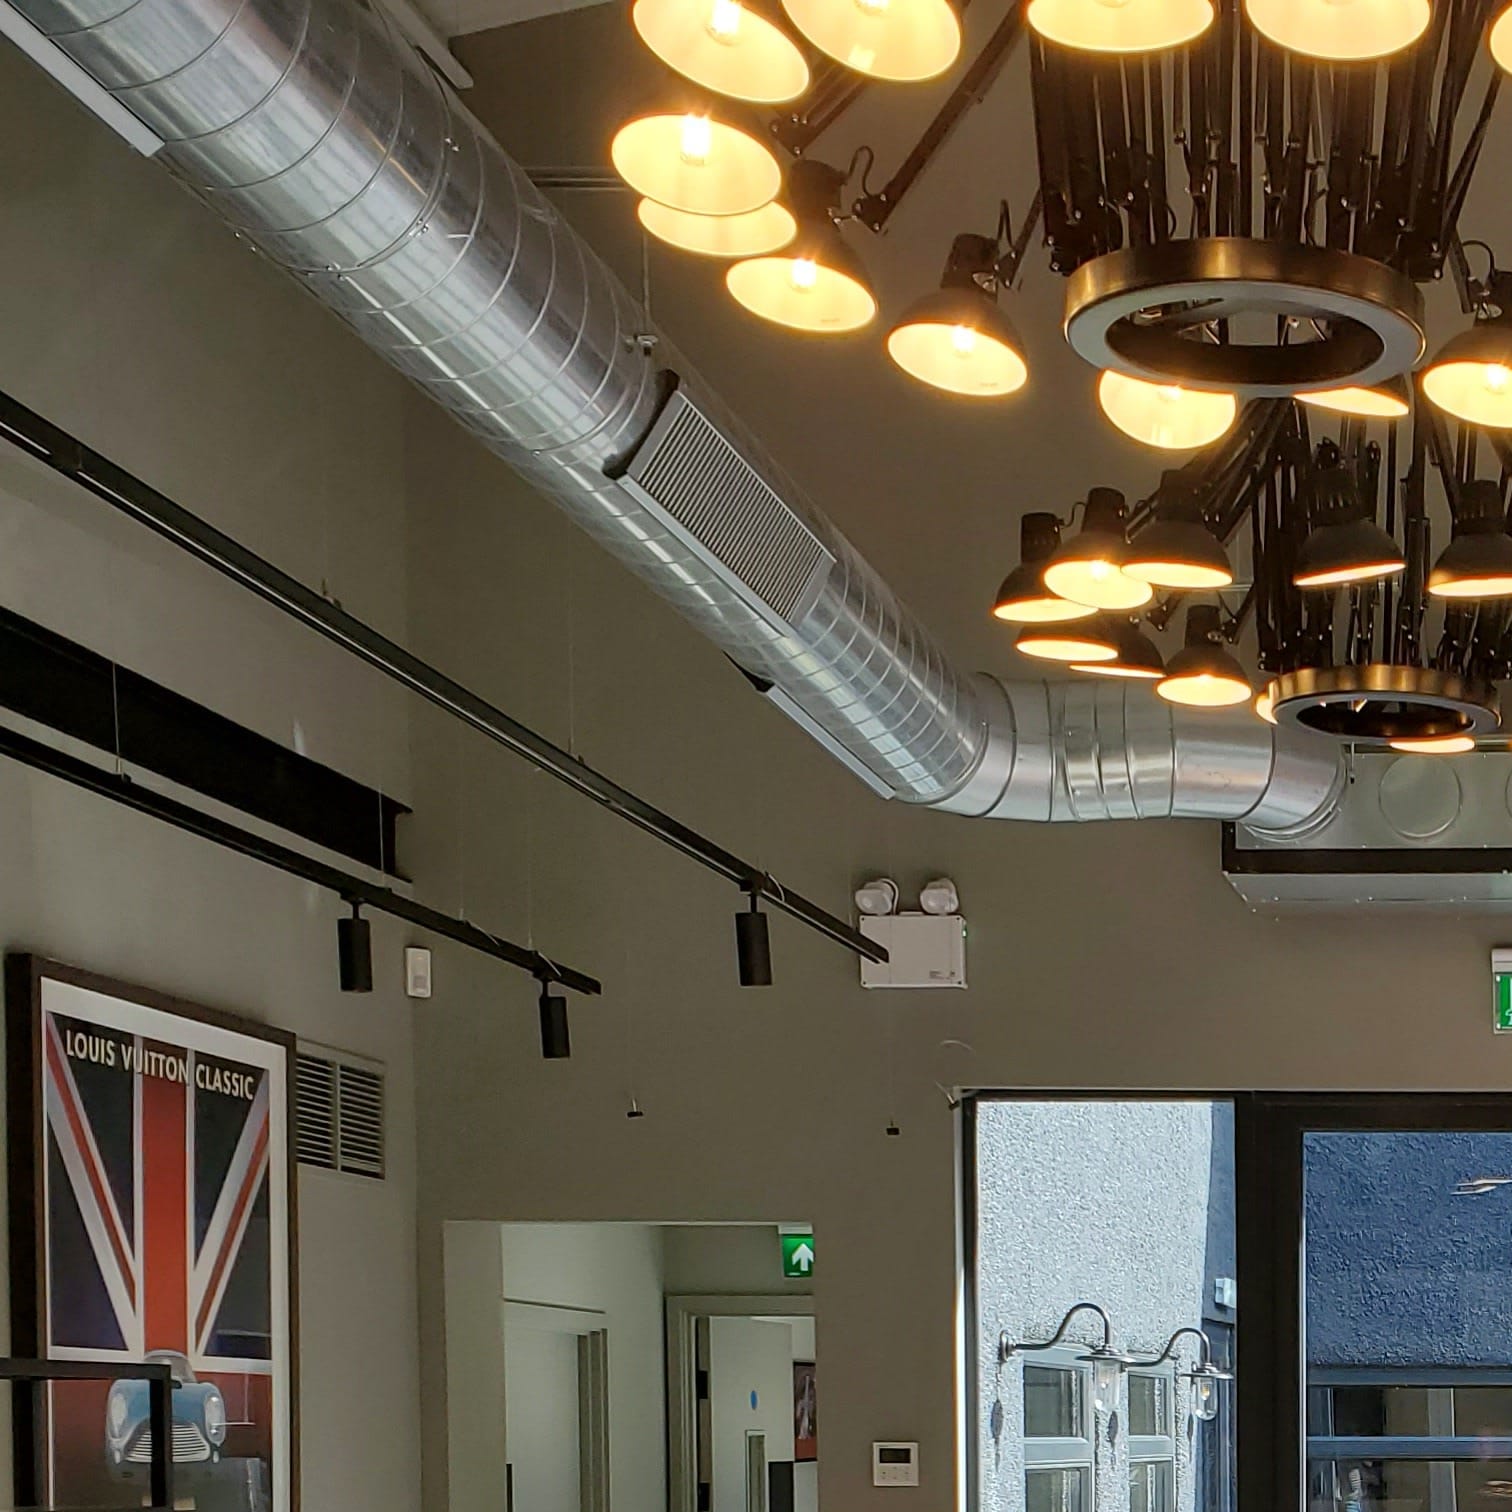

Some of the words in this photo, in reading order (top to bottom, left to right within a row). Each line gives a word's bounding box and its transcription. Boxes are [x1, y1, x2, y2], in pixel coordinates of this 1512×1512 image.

[66, 1029, 115, 1067] LOUIS
[121, 1044, 189, 1083] VUITTON
[195, 1063, 255, 1100] CLASSIC
